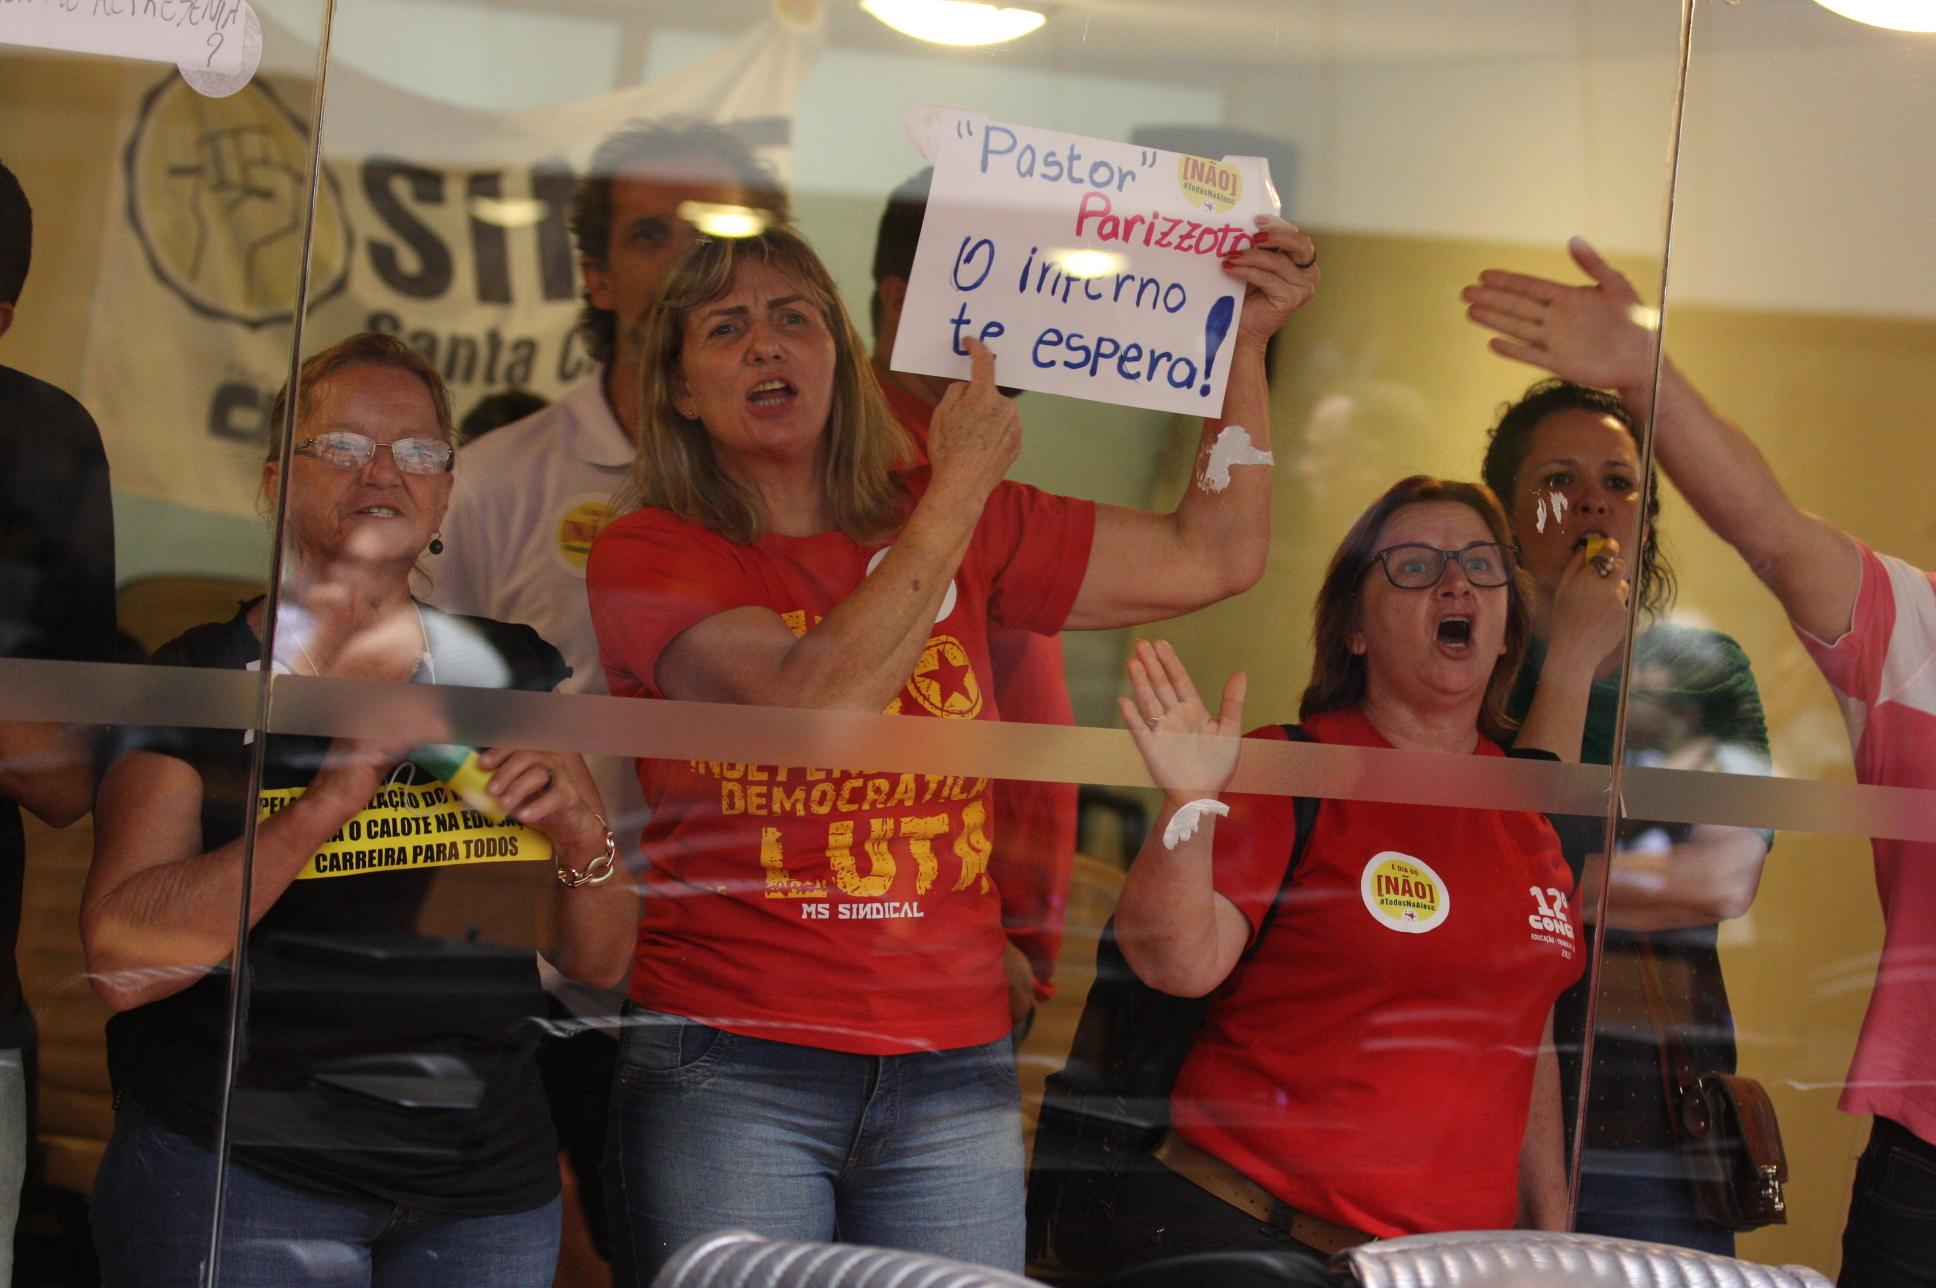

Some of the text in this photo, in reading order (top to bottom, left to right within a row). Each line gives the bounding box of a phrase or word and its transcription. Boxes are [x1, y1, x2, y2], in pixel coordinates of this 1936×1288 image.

[206, 32, 224, 67] ?
[1182, 156, 1237, 197] [NÃO]
[1183, 182, 1235, 205] #TodosNaAlesc
[1075, 191, 1256, 258] Parizzoto
[951, 235, 995, 292] O
[421, 787, 448, 808] DO
[366, 816, 432, 840] CALOTE
[435, 811, 460, 833] NA
[315, 836, 518, 873] CARREIRA PARA TODOS
[1377, 874, 1434, 904] [NÃO]
[802, 901, 924, 920] MS SINDICAL
[1380, 898, 1435, 911] #TodosNaAlesc
